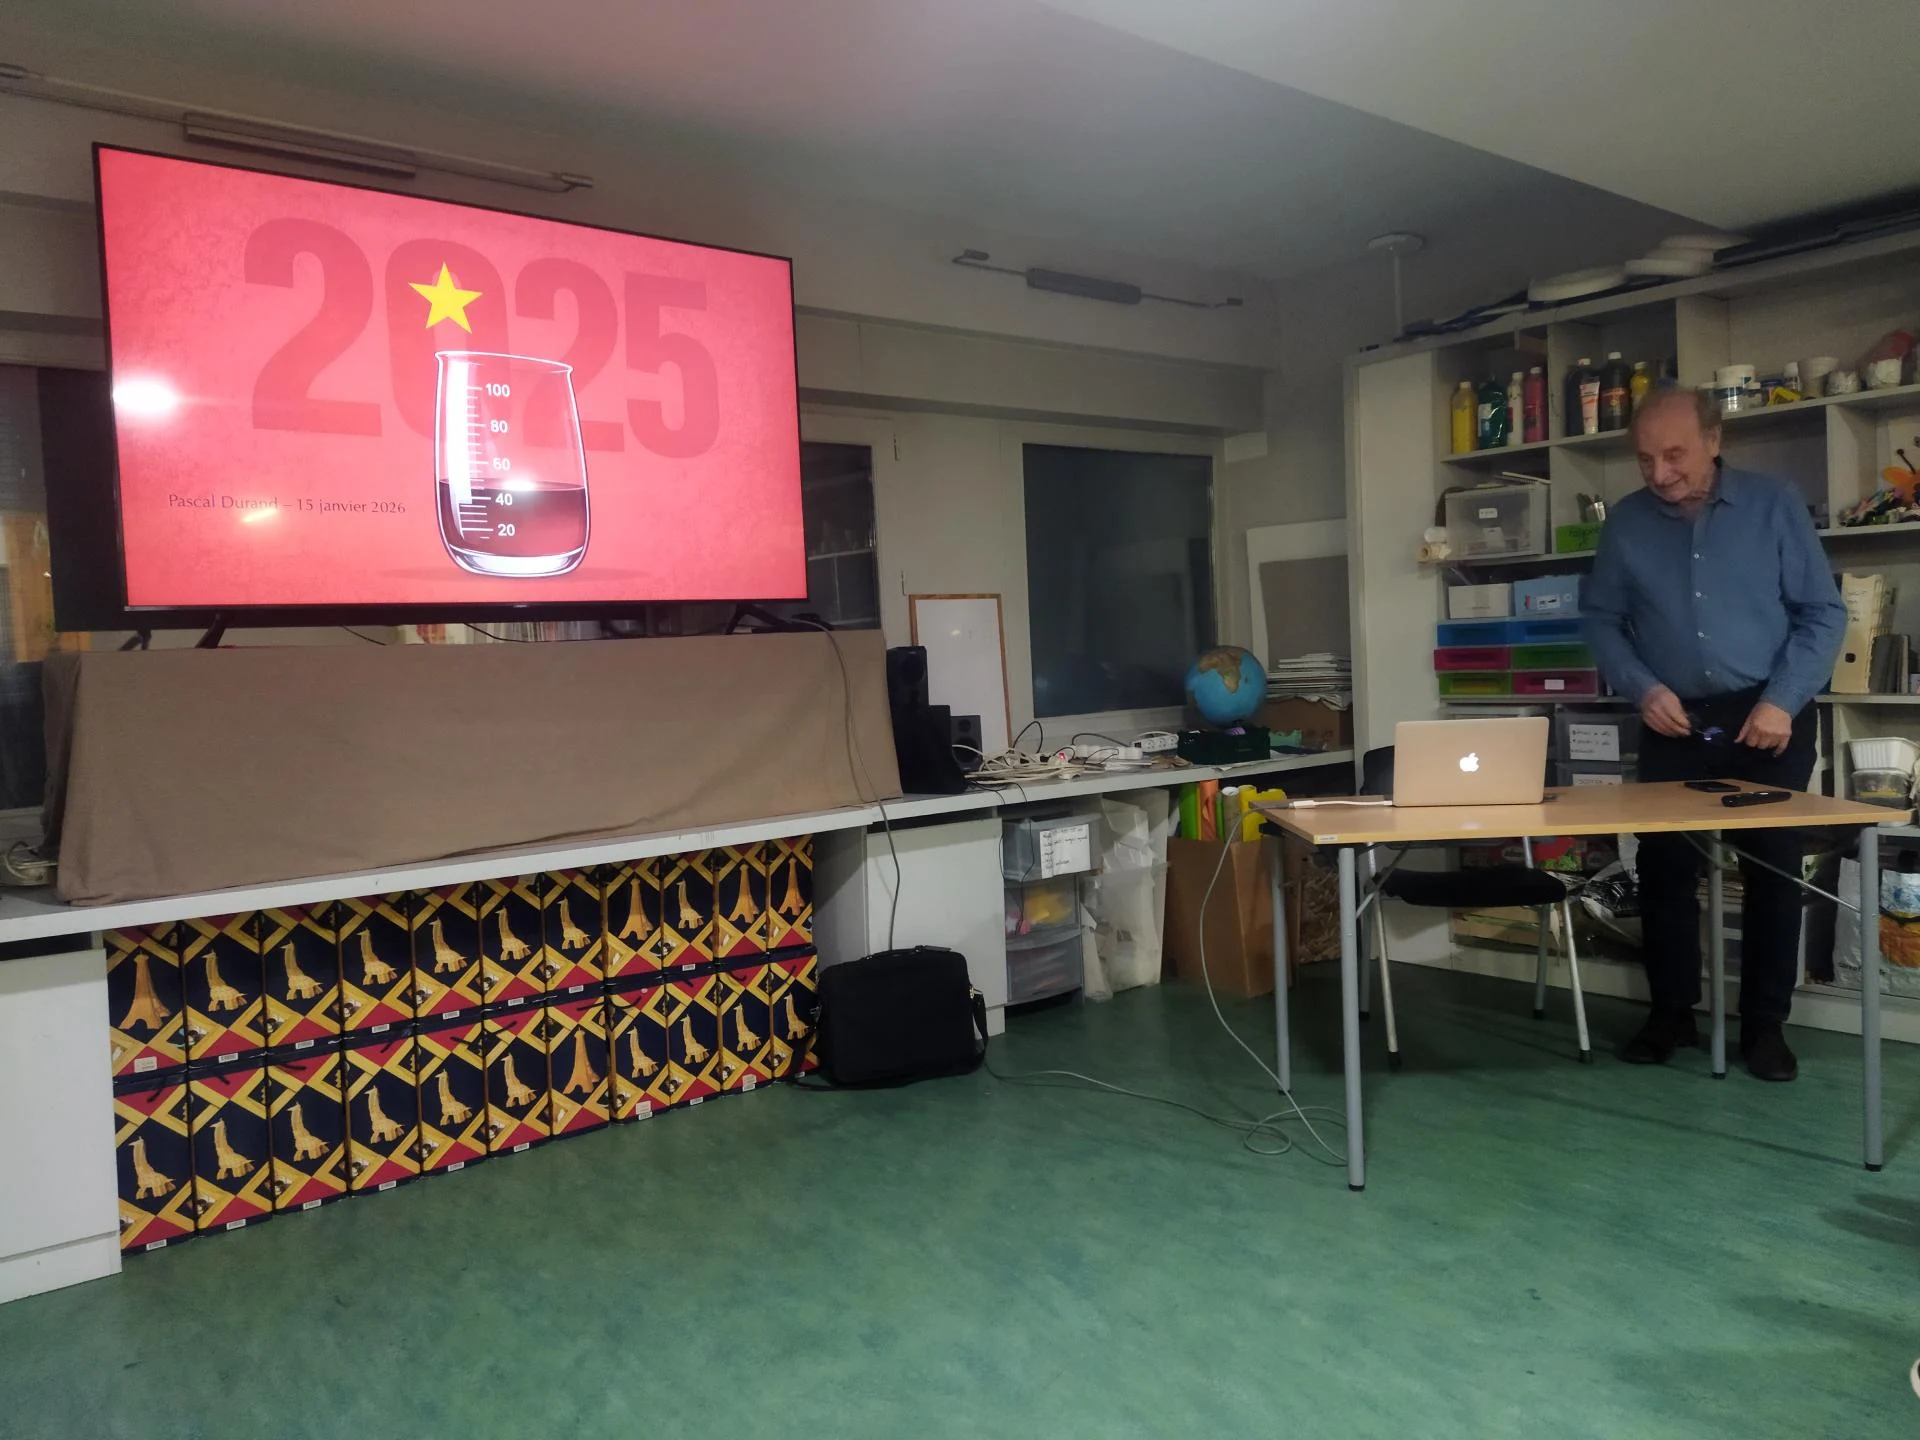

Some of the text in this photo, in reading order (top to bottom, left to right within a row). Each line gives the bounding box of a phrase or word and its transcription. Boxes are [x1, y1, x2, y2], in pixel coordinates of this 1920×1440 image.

[244, 217, 720, 459] 2025
[485, 383, 511, 397] 100
[490, 419, 509, 433] 80
[492, 457, 511, 471] 60
[168, 494, 216, 509] Pascal
[221, 495, 279, 510] Durand
[298, 498, 314, 512] 15
[319, 499, 367, 514] janvier
[371, 501, 406, 514] 2026
[495, 493, 513, 506] 40
[497, 523, 516, 537] 20
